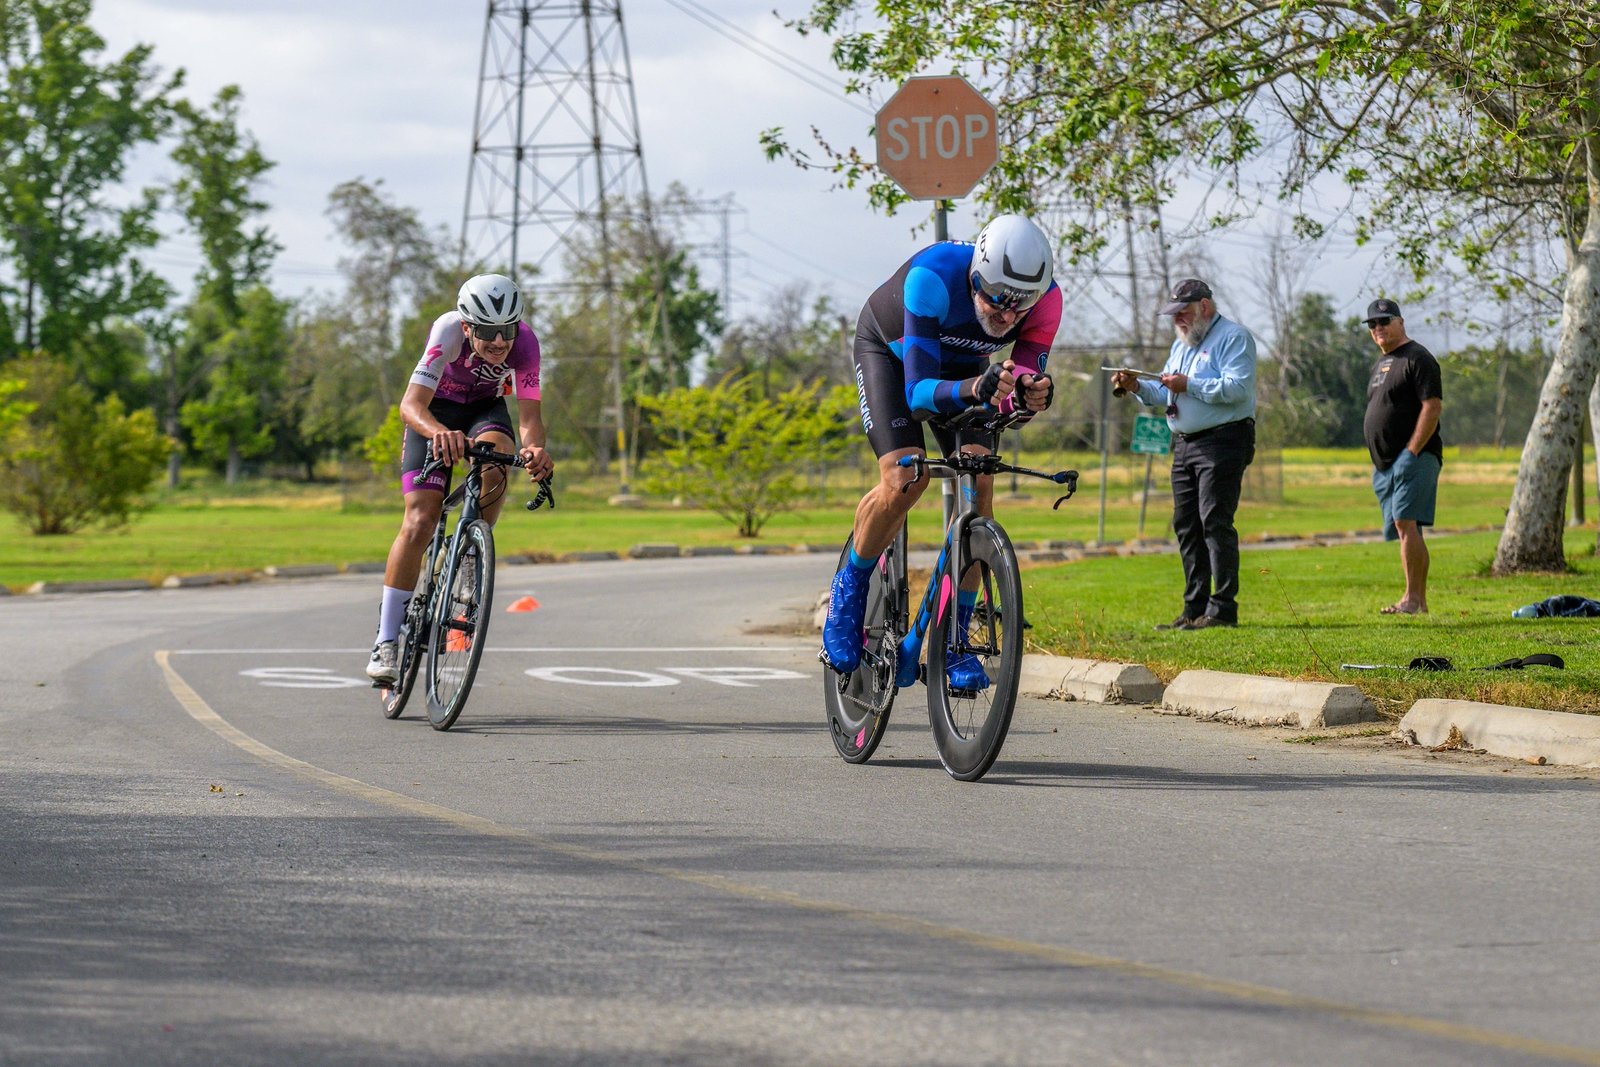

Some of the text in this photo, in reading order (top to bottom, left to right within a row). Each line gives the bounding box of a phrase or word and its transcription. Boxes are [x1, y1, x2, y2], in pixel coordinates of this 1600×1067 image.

[887, 115, 989, 161] STOP
[980, 225, 990, 264] UDY
[239, 666, 813, 690] SOP
